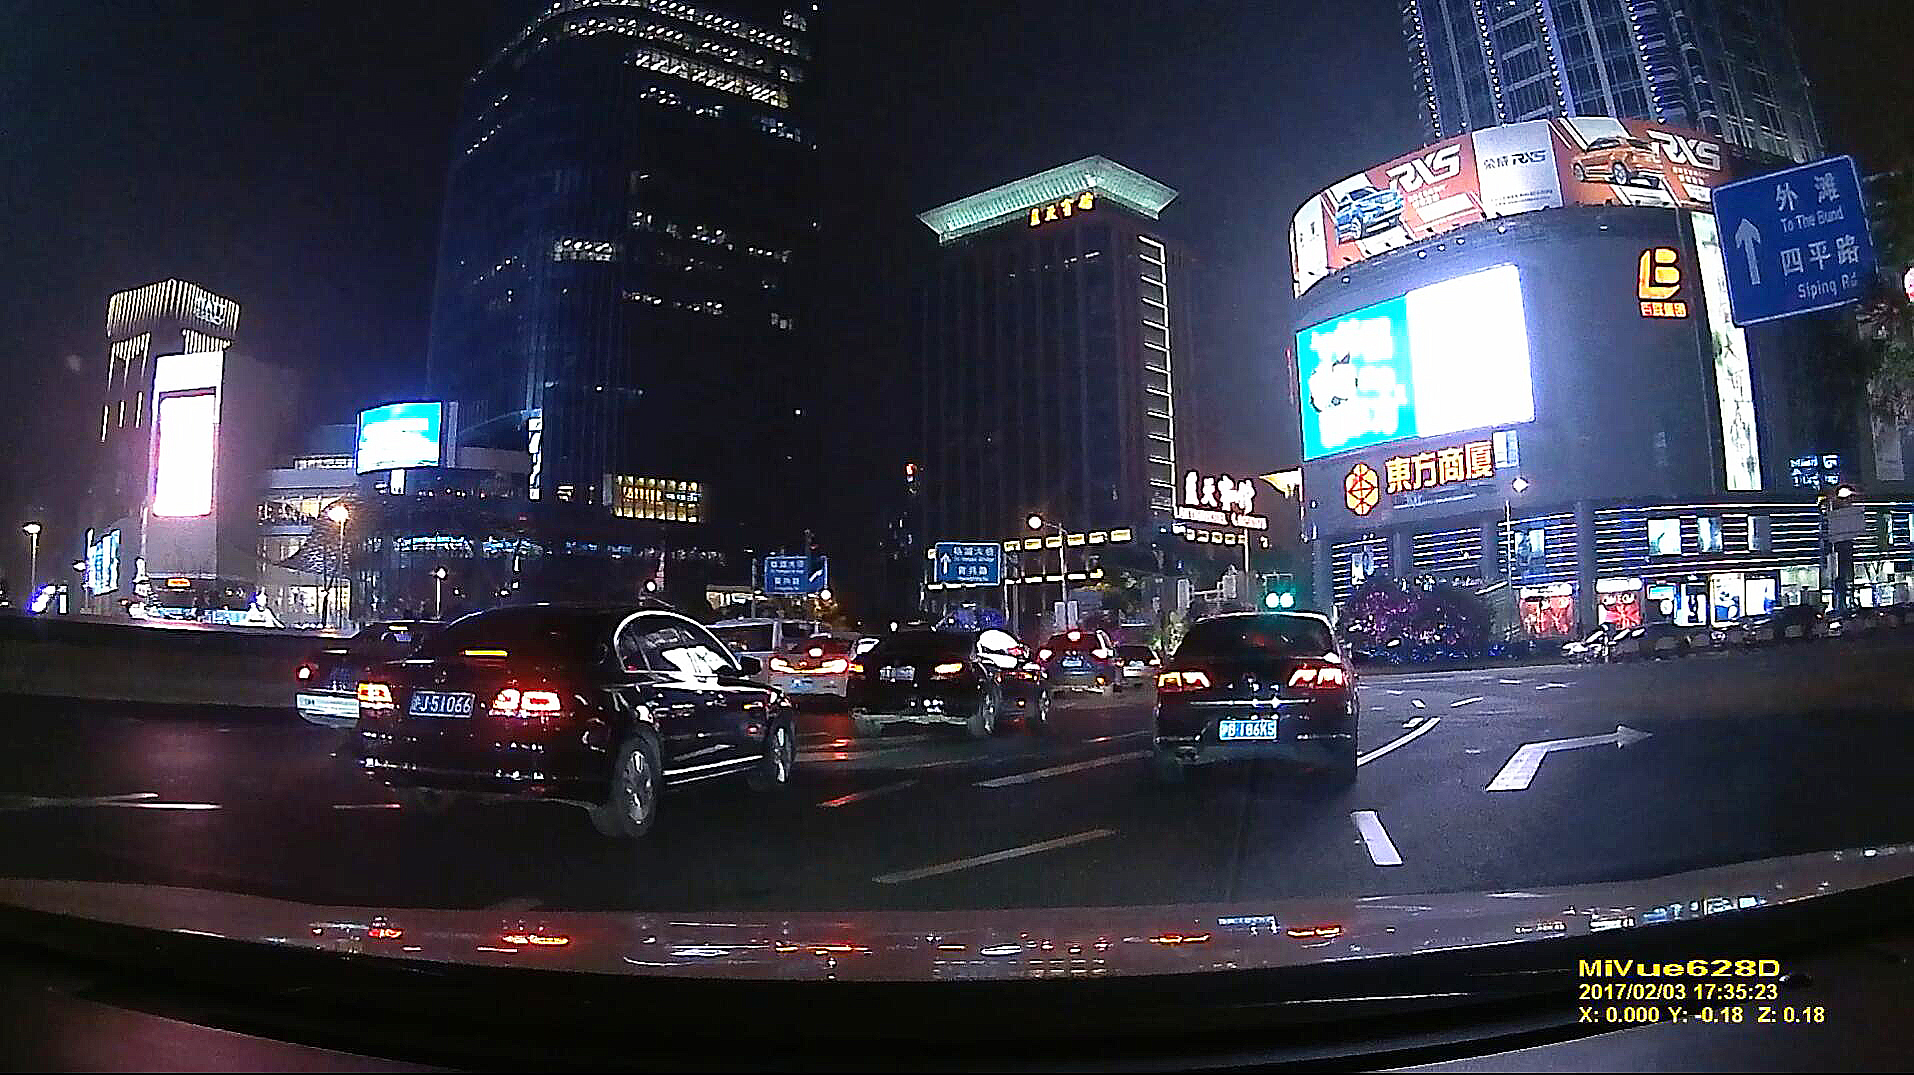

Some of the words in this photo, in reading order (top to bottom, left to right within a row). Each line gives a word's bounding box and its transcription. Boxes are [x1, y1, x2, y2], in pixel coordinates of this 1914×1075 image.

[1776, 172, 1840, 212] 外滩
[1780, 218, 1795, 233] To
[1795, 214, 1816, 230] The
[1816, 205, 1845, 225] Bund
[1780, 234, 1860, 277] 四平路
[1798, 278, 1838, 299] Siping
